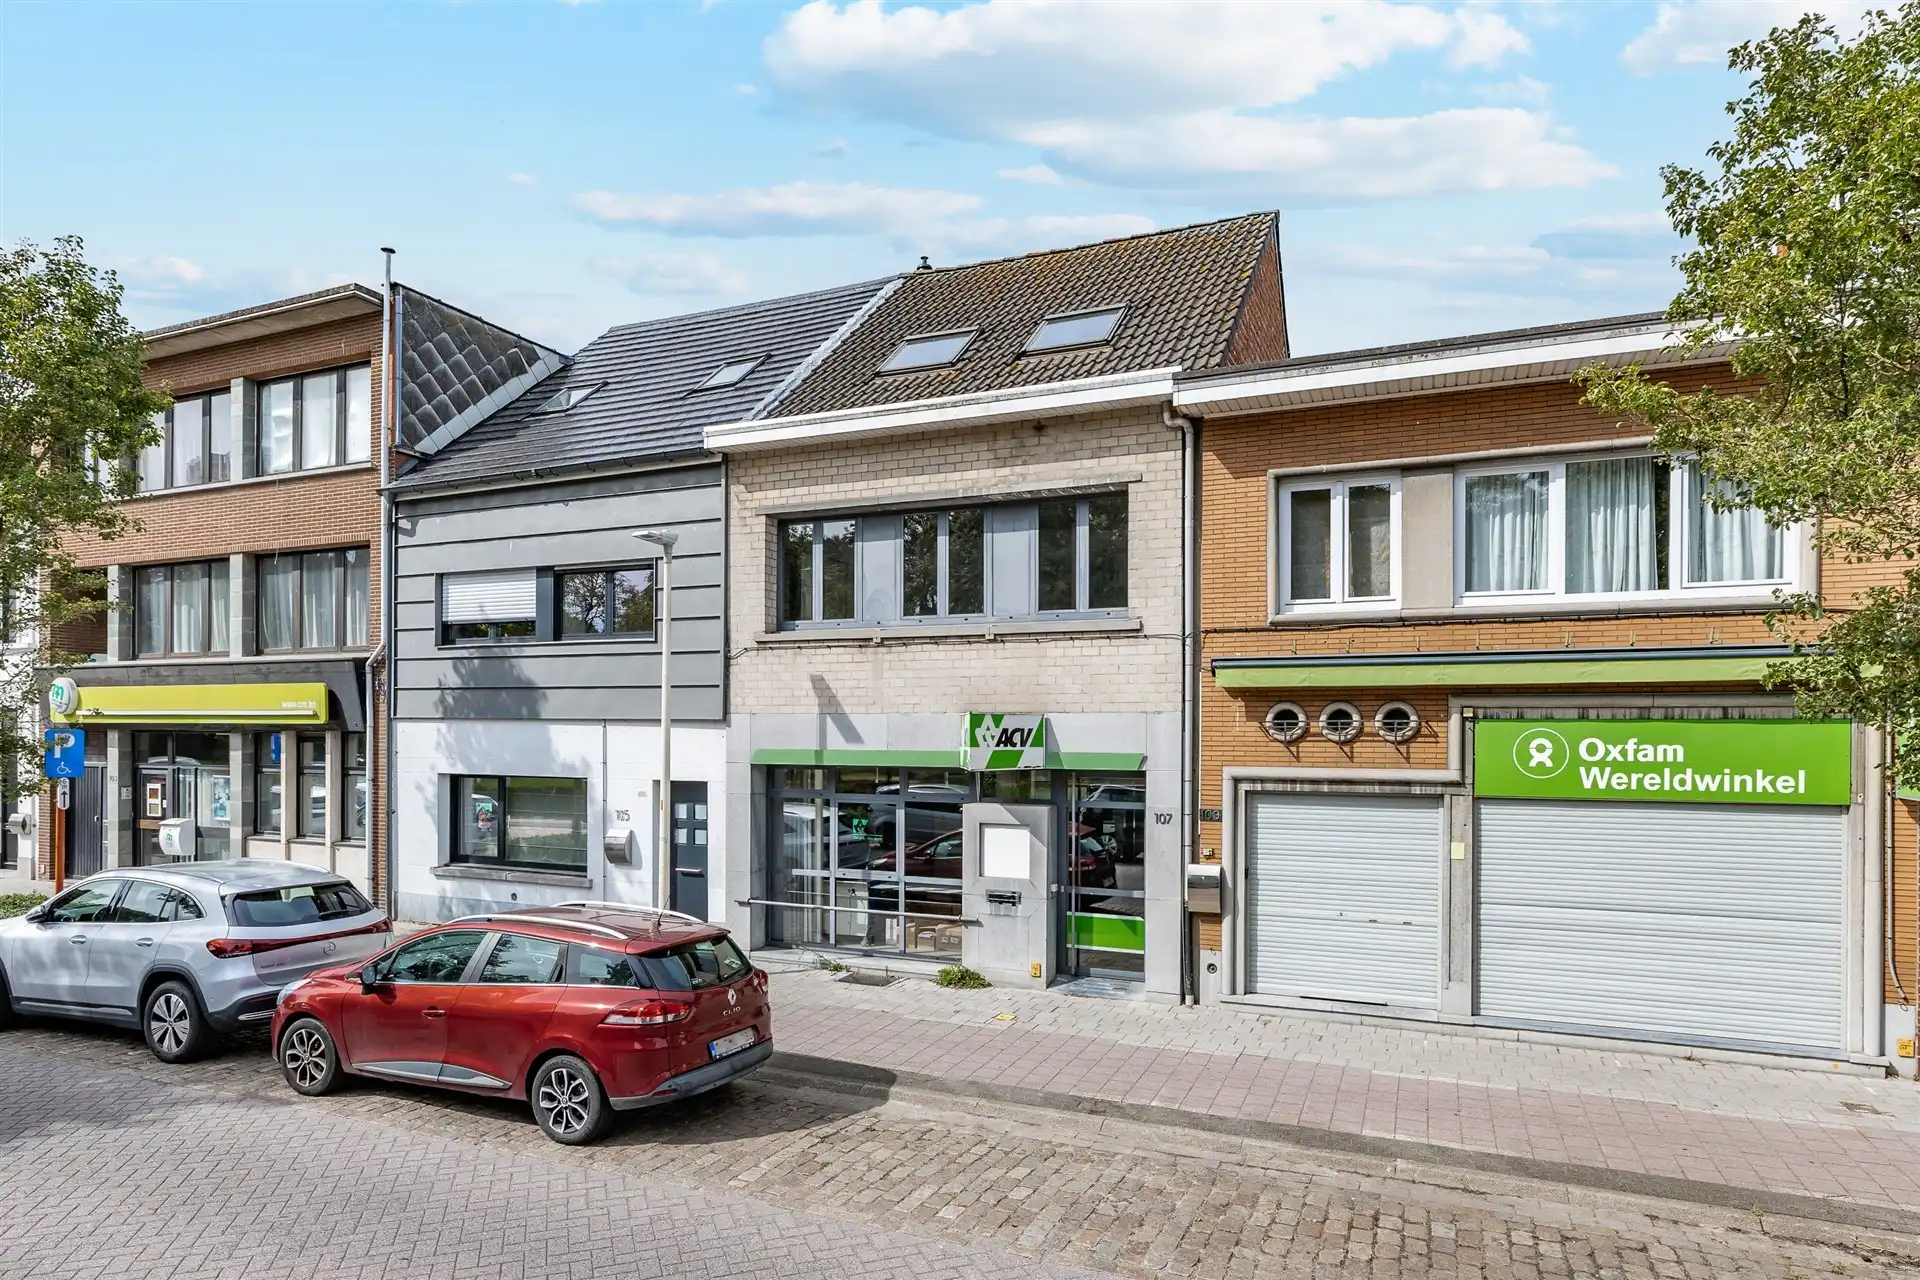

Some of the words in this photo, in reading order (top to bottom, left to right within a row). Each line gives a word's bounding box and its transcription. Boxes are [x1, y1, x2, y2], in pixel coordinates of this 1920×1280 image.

[54, 733, 75, 758] P
[995, 727, 1035, 748] ACV
[1578, 737, 1684, 763] Oxfam
[1578, 766, 1806, 794] Wereldwinkel
[615, 809, 631, 822] 105
[1154, 812, 1173, 825] 107
[1201, 809, 1220, 820] 109
[723, 1006, 741, 1016] CLIO
